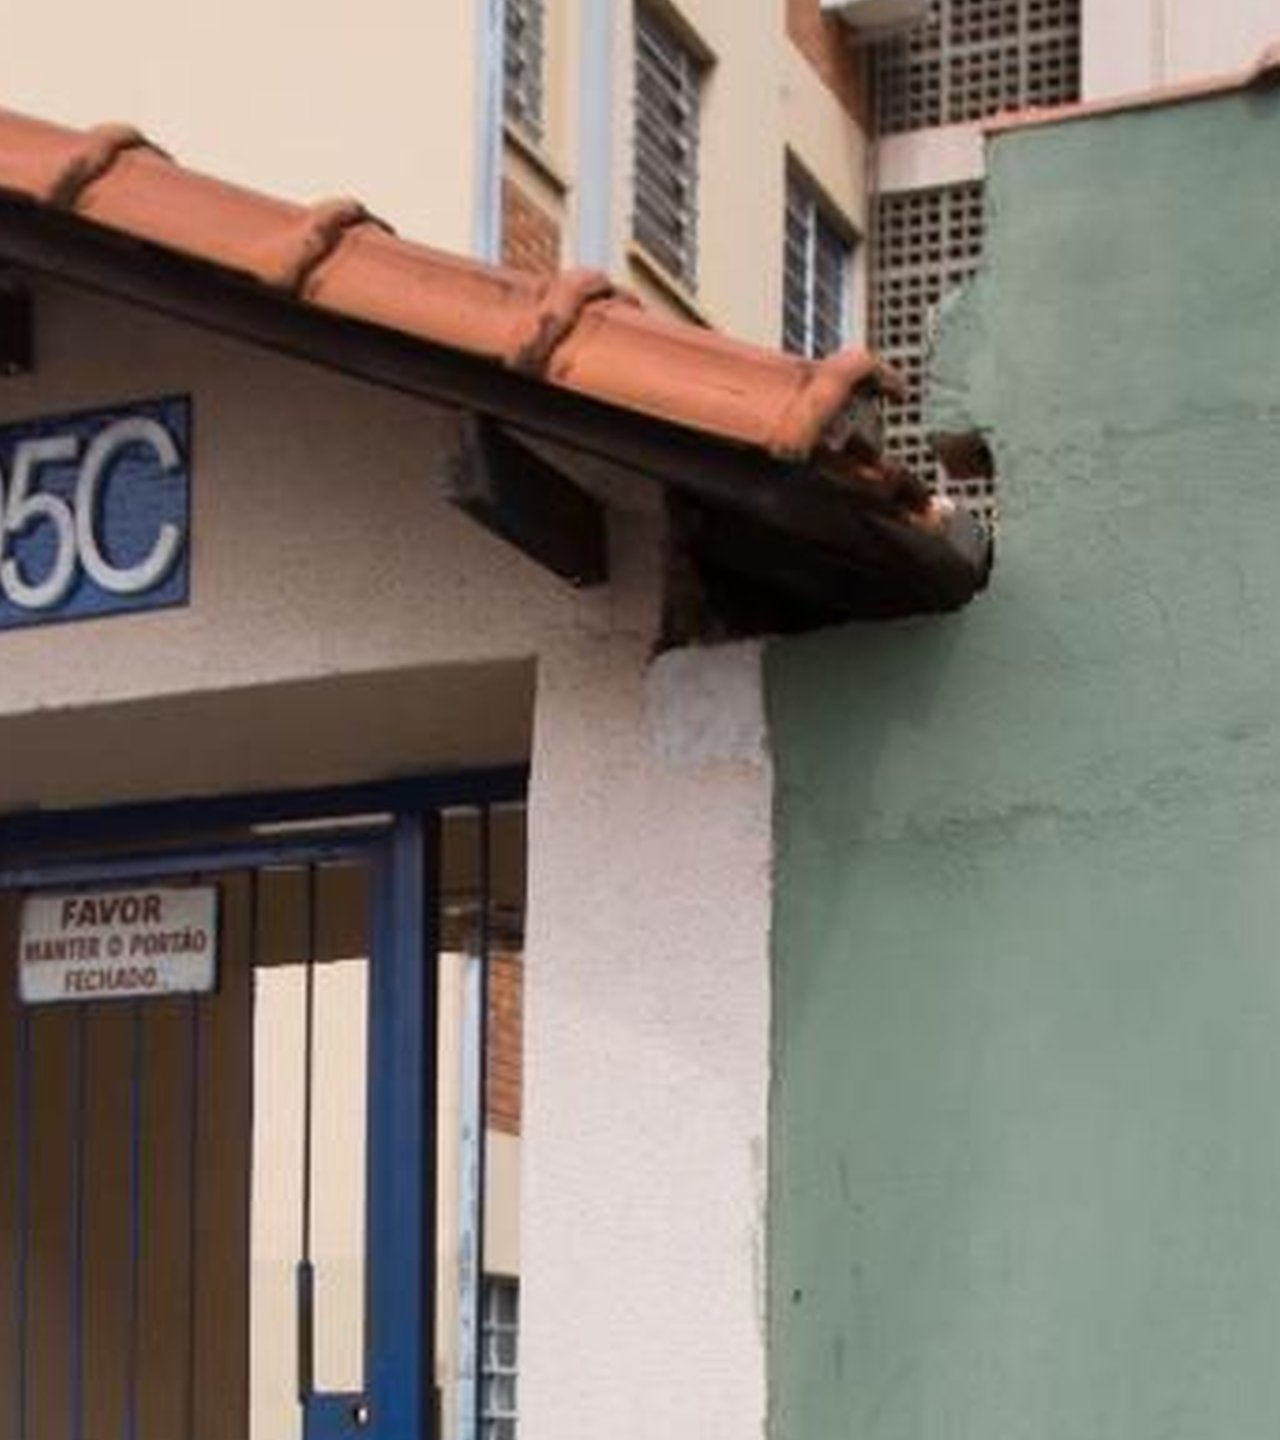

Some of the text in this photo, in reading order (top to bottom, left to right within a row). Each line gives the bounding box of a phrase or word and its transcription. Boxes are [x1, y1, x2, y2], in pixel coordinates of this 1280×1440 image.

[61, 894, 162, 930] FAVOR
[24, 936, 101, 961] MANTER
[107, 934, 123, 957] O
[64, 967, 158, 992] FECHADO
